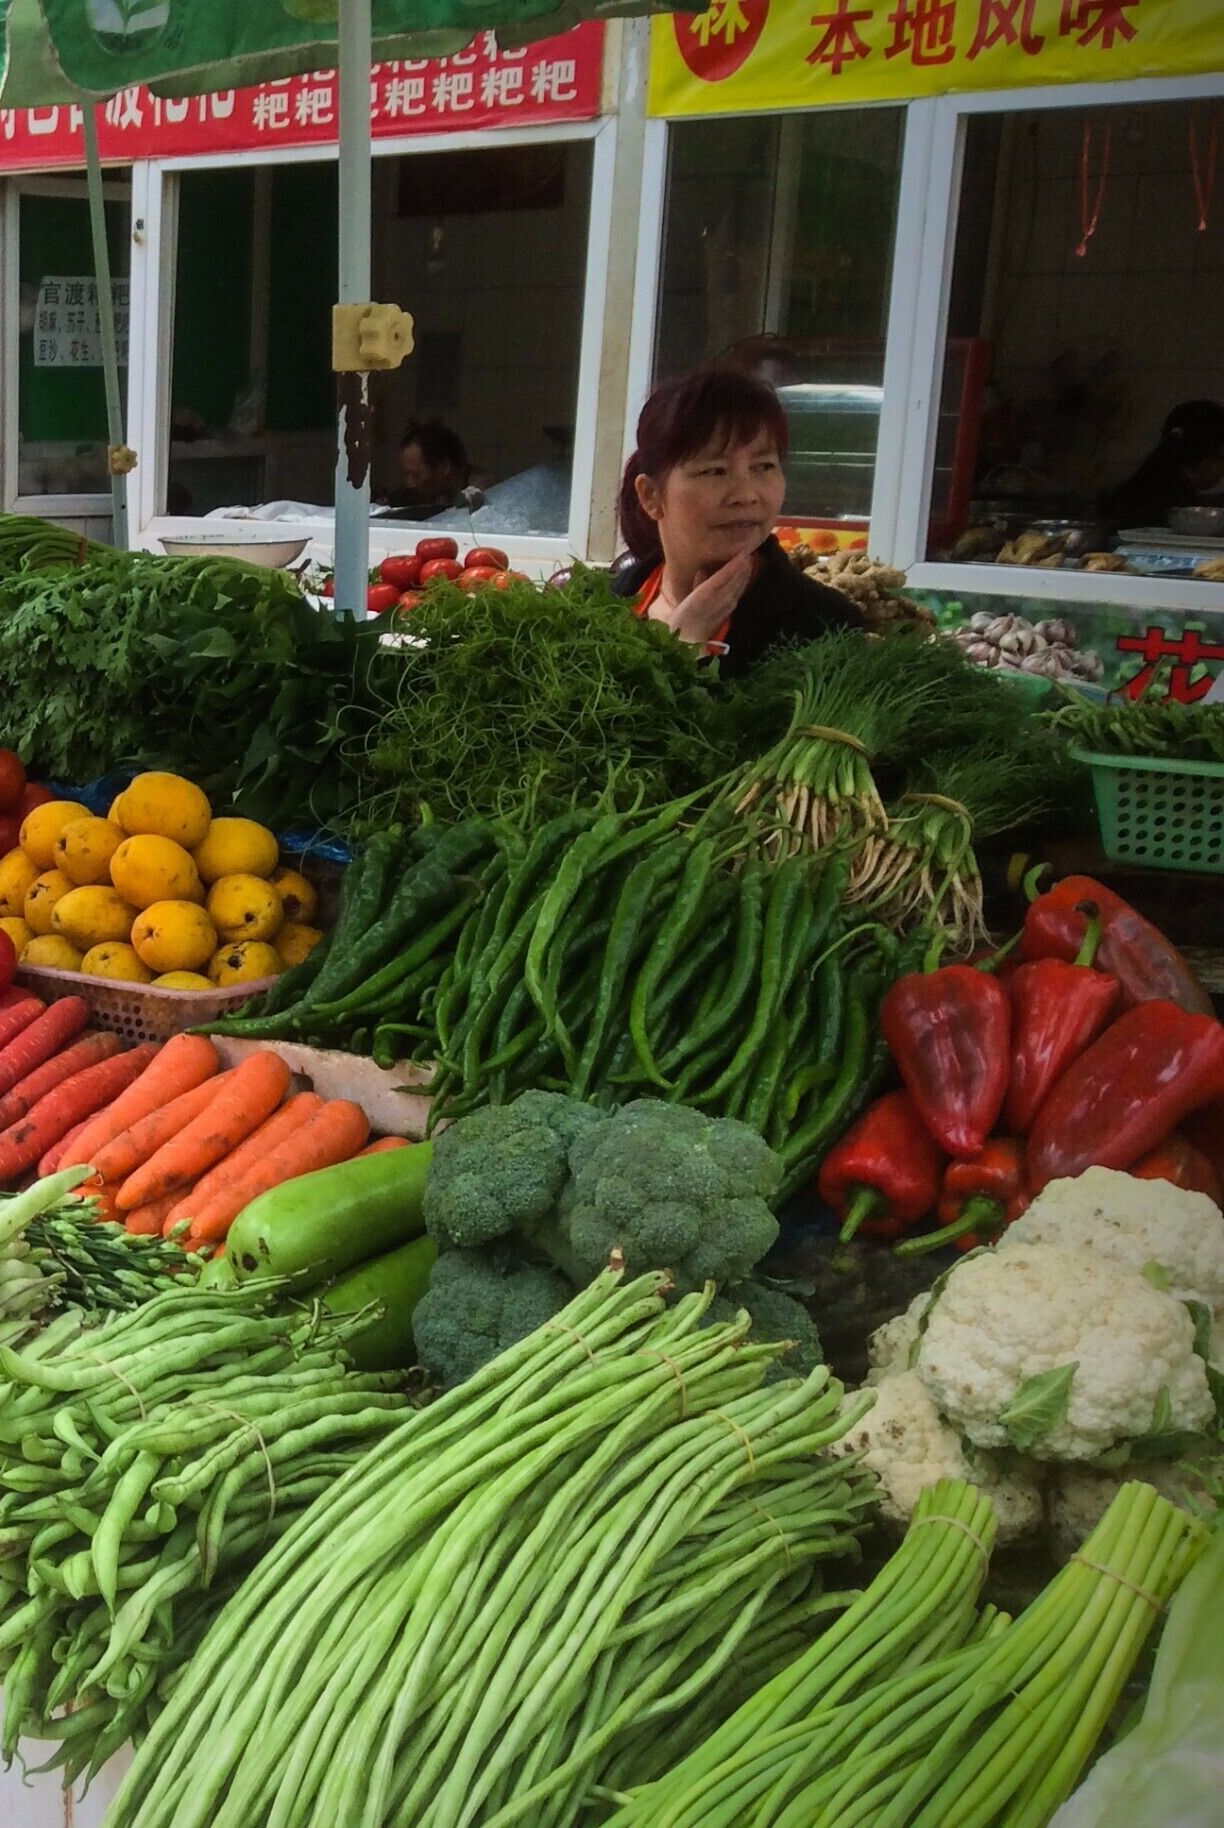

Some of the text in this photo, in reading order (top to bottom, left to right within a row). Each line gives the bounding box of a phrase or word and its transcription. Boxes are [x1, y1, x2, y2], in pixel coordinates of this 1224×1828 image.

[252, 59, 578, 131] 粑粑粑粑粑粑
